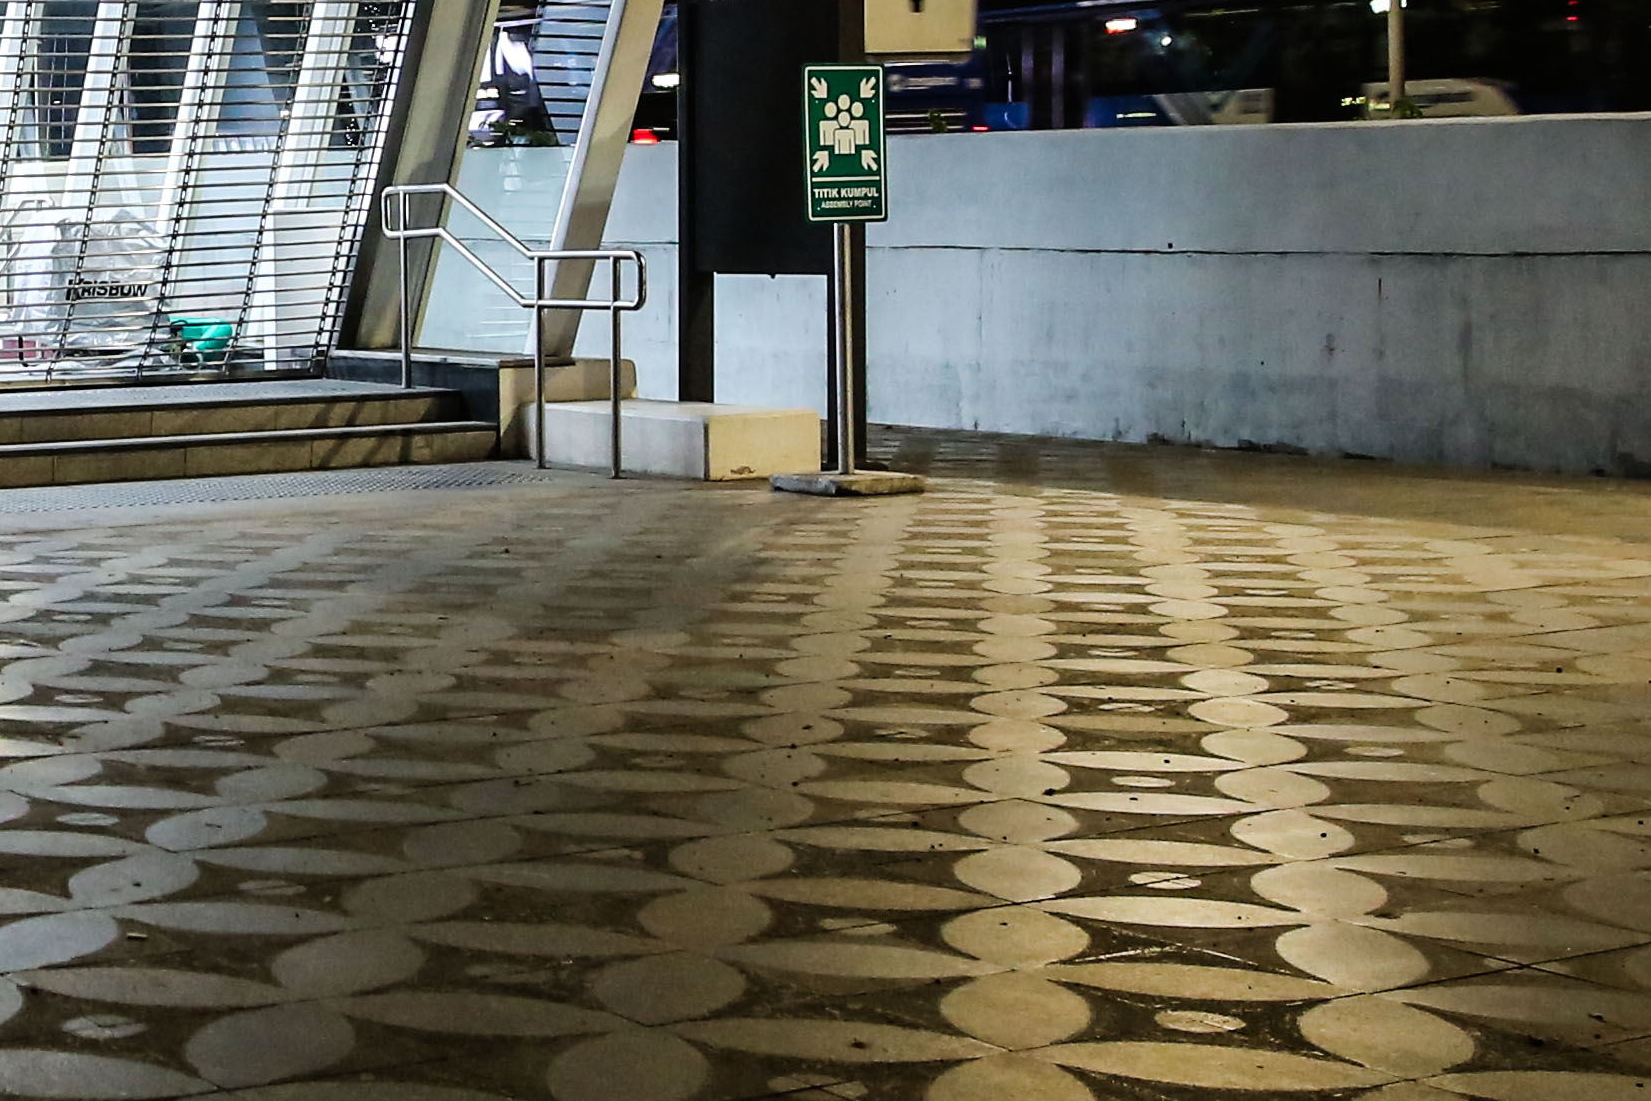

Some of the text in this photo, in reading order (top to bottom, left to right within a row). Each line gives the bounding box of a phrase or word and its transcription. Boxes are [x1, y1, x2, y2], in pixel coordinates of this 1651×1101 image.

[813, 187, 879, 198] TITIK KUMPUL
[65, 278, 148, 300] KRISBOW
